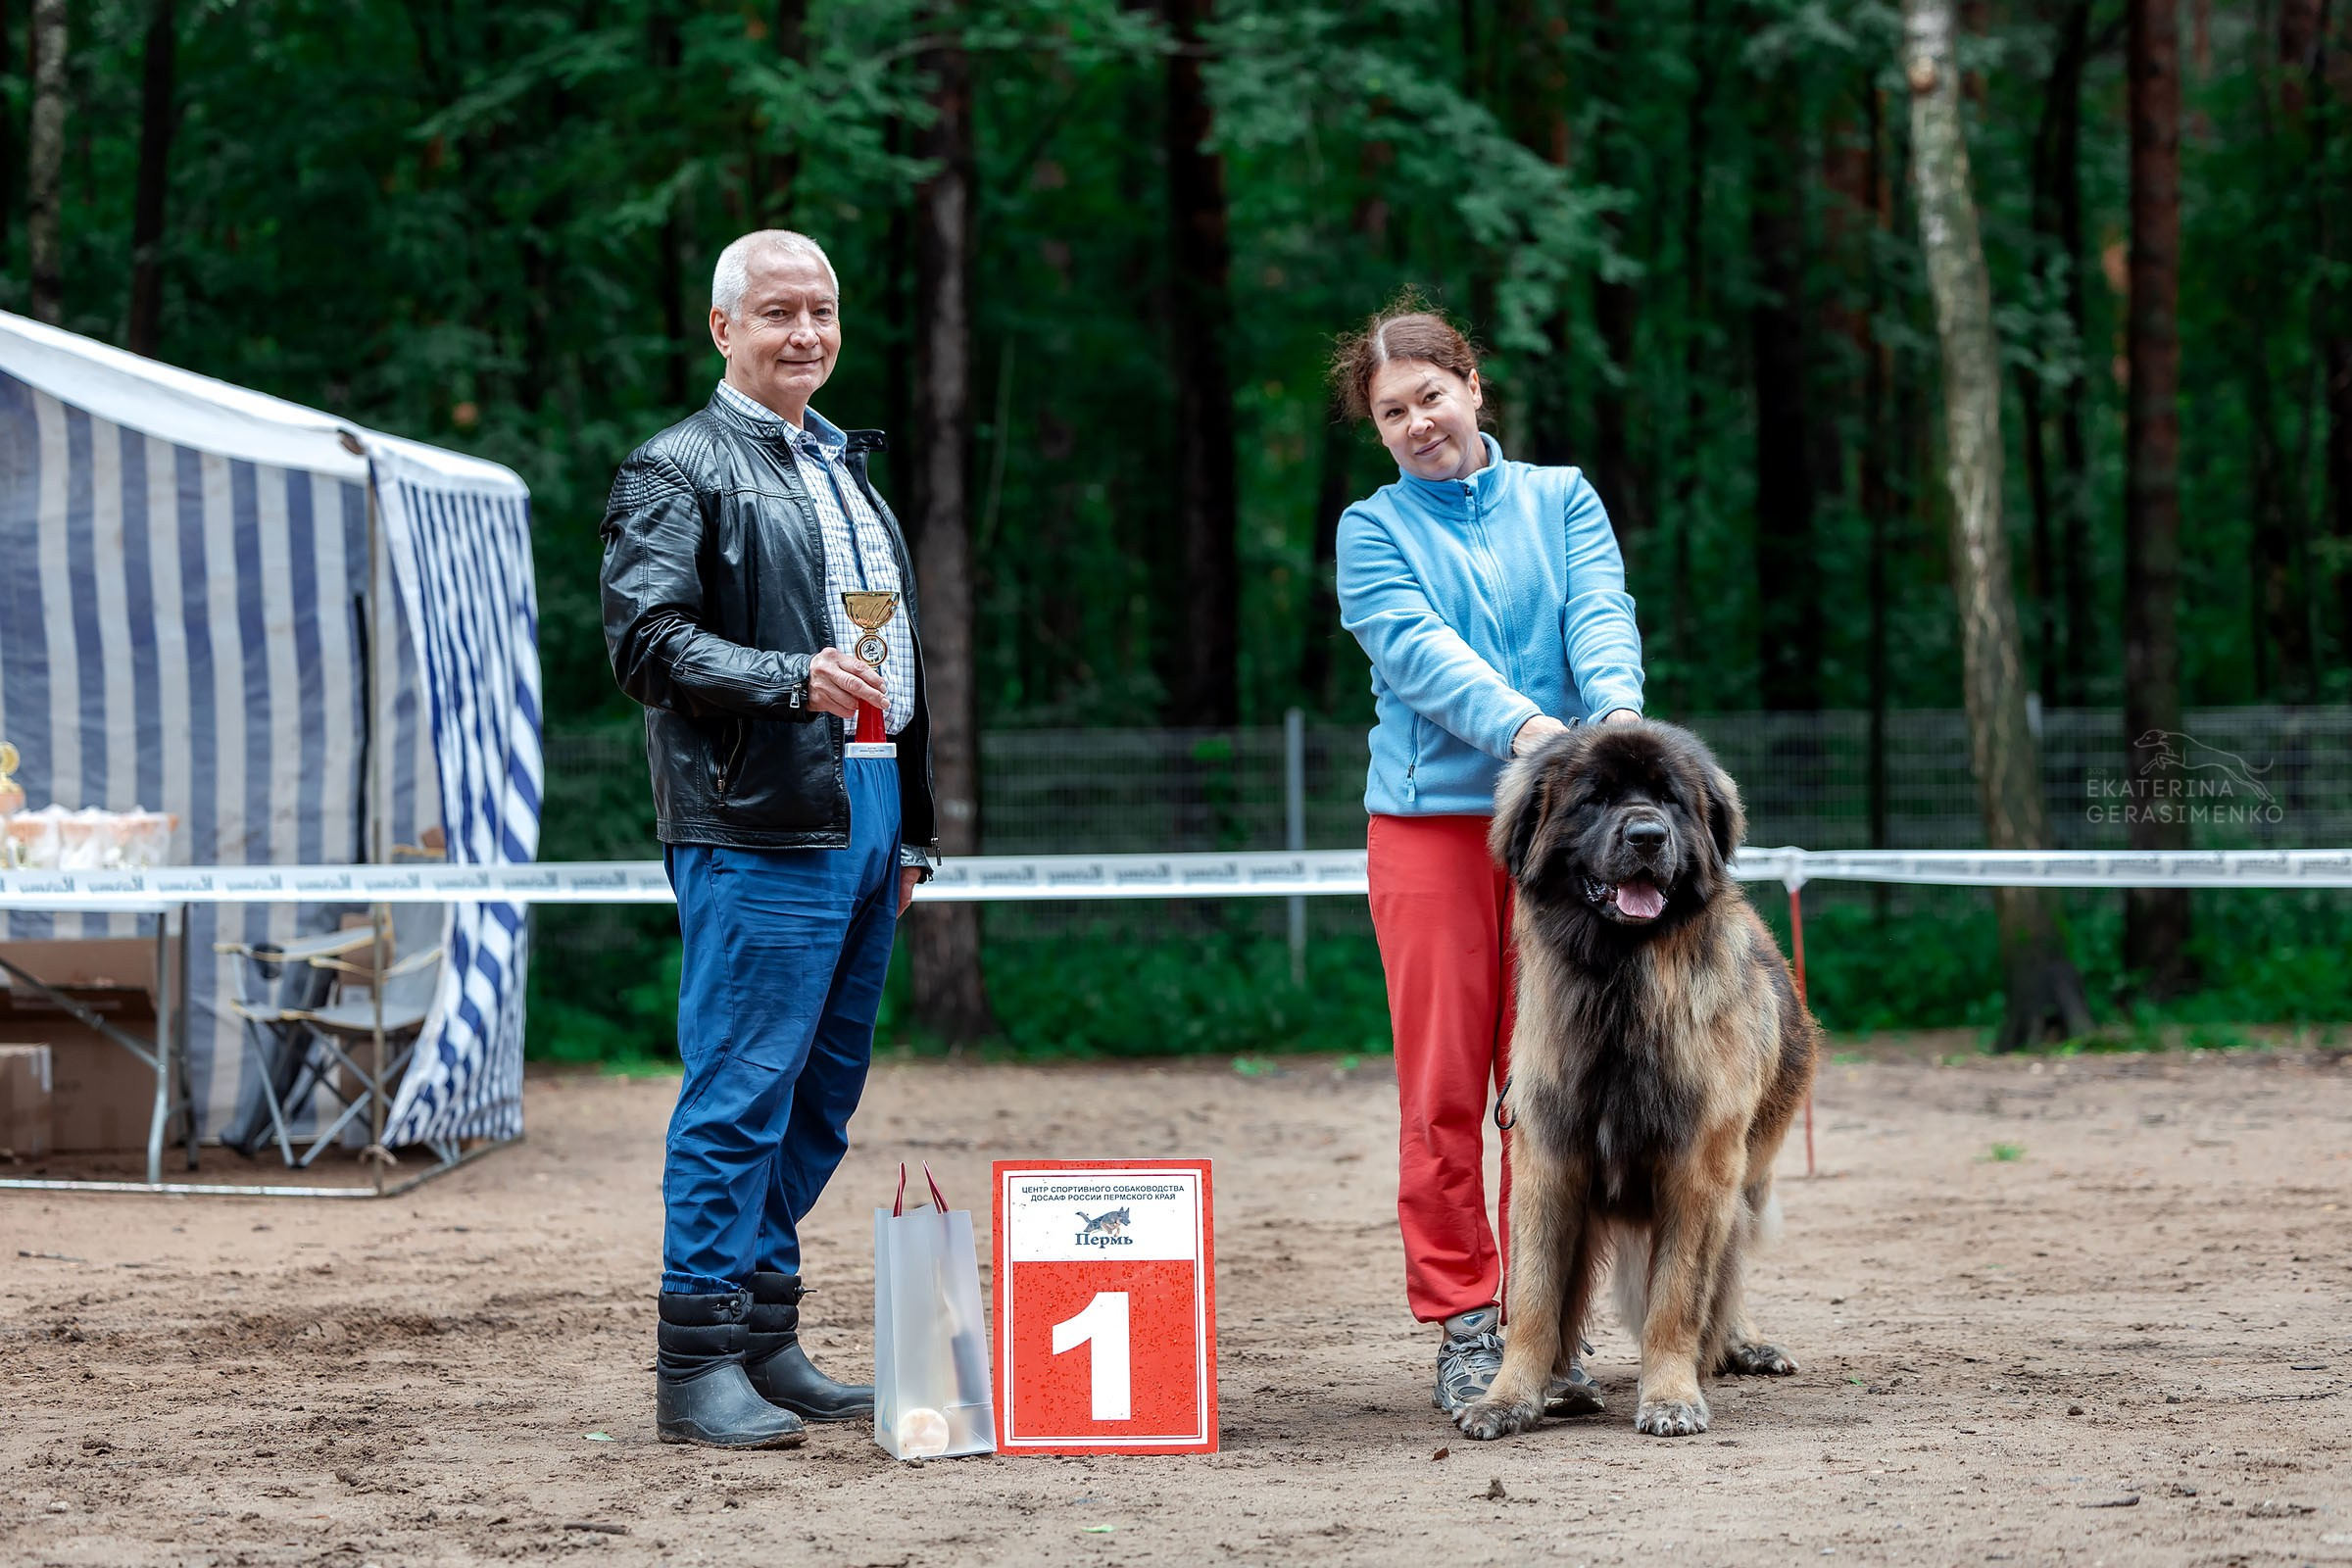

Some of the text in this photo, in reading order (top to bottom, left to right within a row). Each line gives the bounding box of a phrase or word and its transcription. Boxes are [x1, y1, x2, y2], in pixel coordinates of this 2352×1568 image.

[1051, 1185, 1111, 1194] СПОРТИВНОГО
[1030, 1194, 1066, 1202] ДОСААФ
[1075, 1233, 1133, 1249] Пермь
[1052, 1291, 1132, 1421] 1
